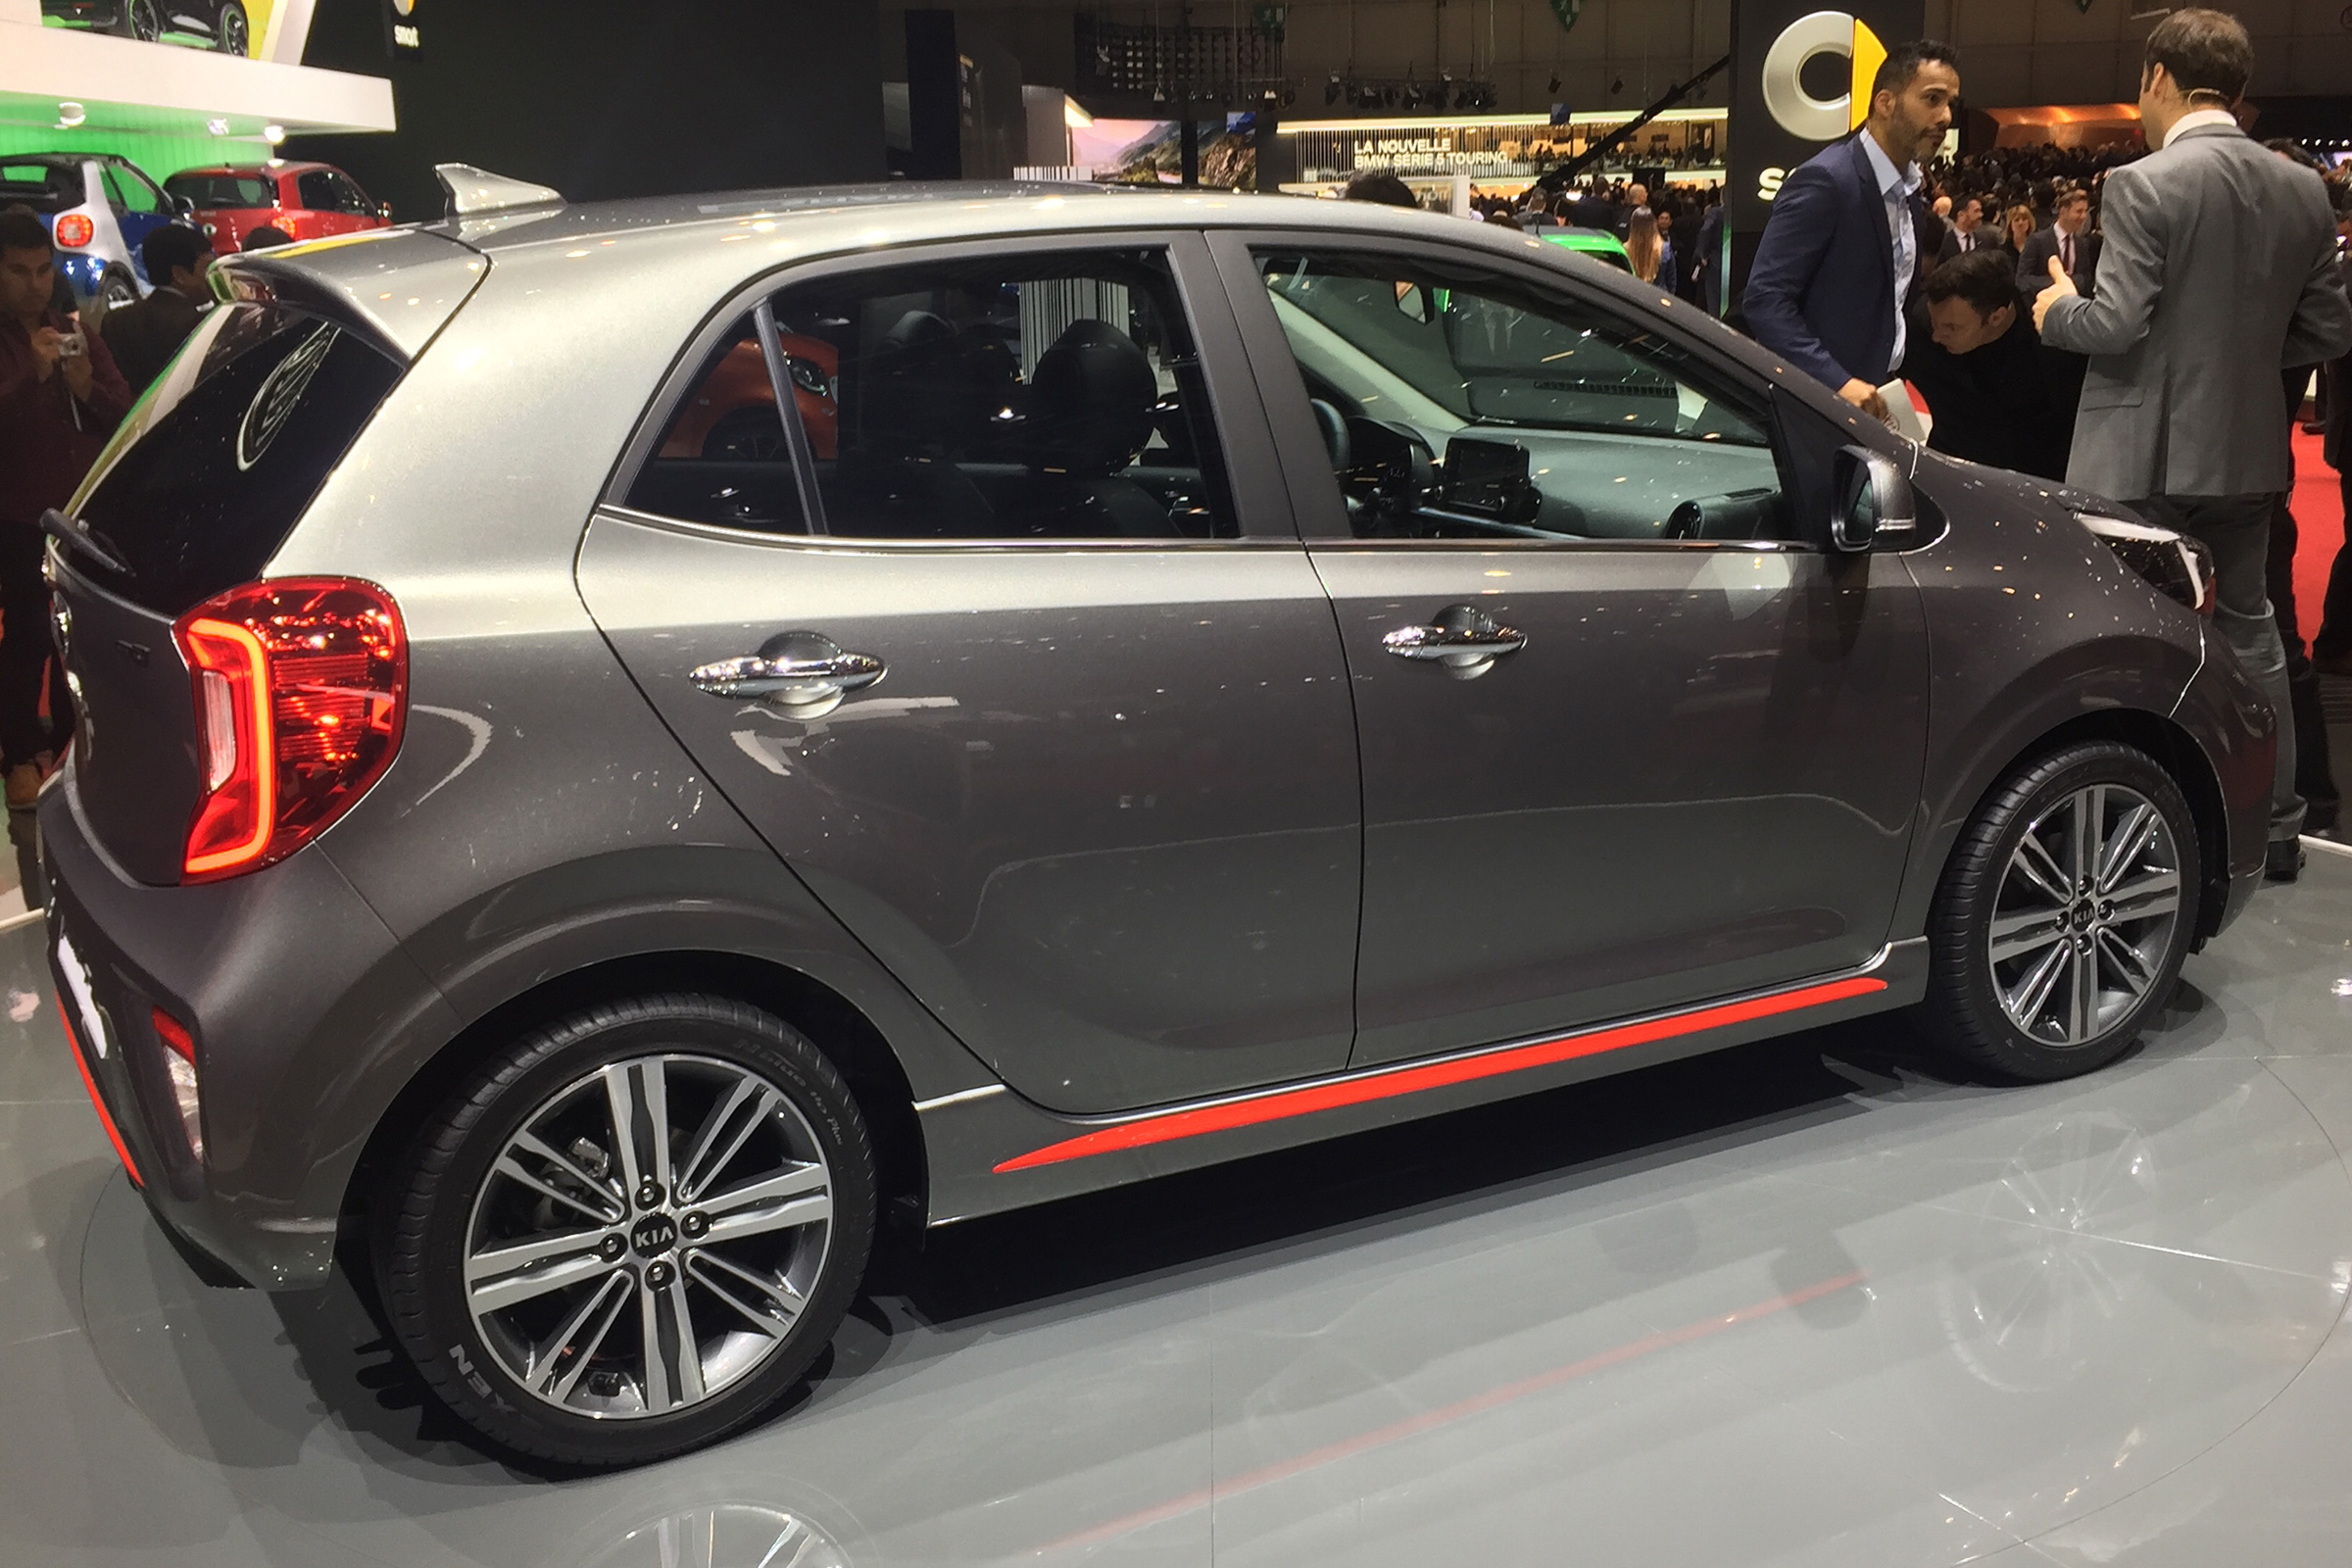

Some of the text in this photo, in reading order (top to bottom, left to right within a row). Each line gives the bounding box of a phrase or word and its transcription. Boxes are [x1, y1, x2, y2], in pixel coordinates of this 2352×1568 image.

[1354, 137, 1451, 155] LA NOUVELLE
[1354, 154, 1390, 170] BMW
[1393, 151, 1434, 168] SÉRIE
[1435, 152, 1446, 167] 5
[2074, 907, 2095, 925] KIA
[635, 1225, 675, 1249] KIA
